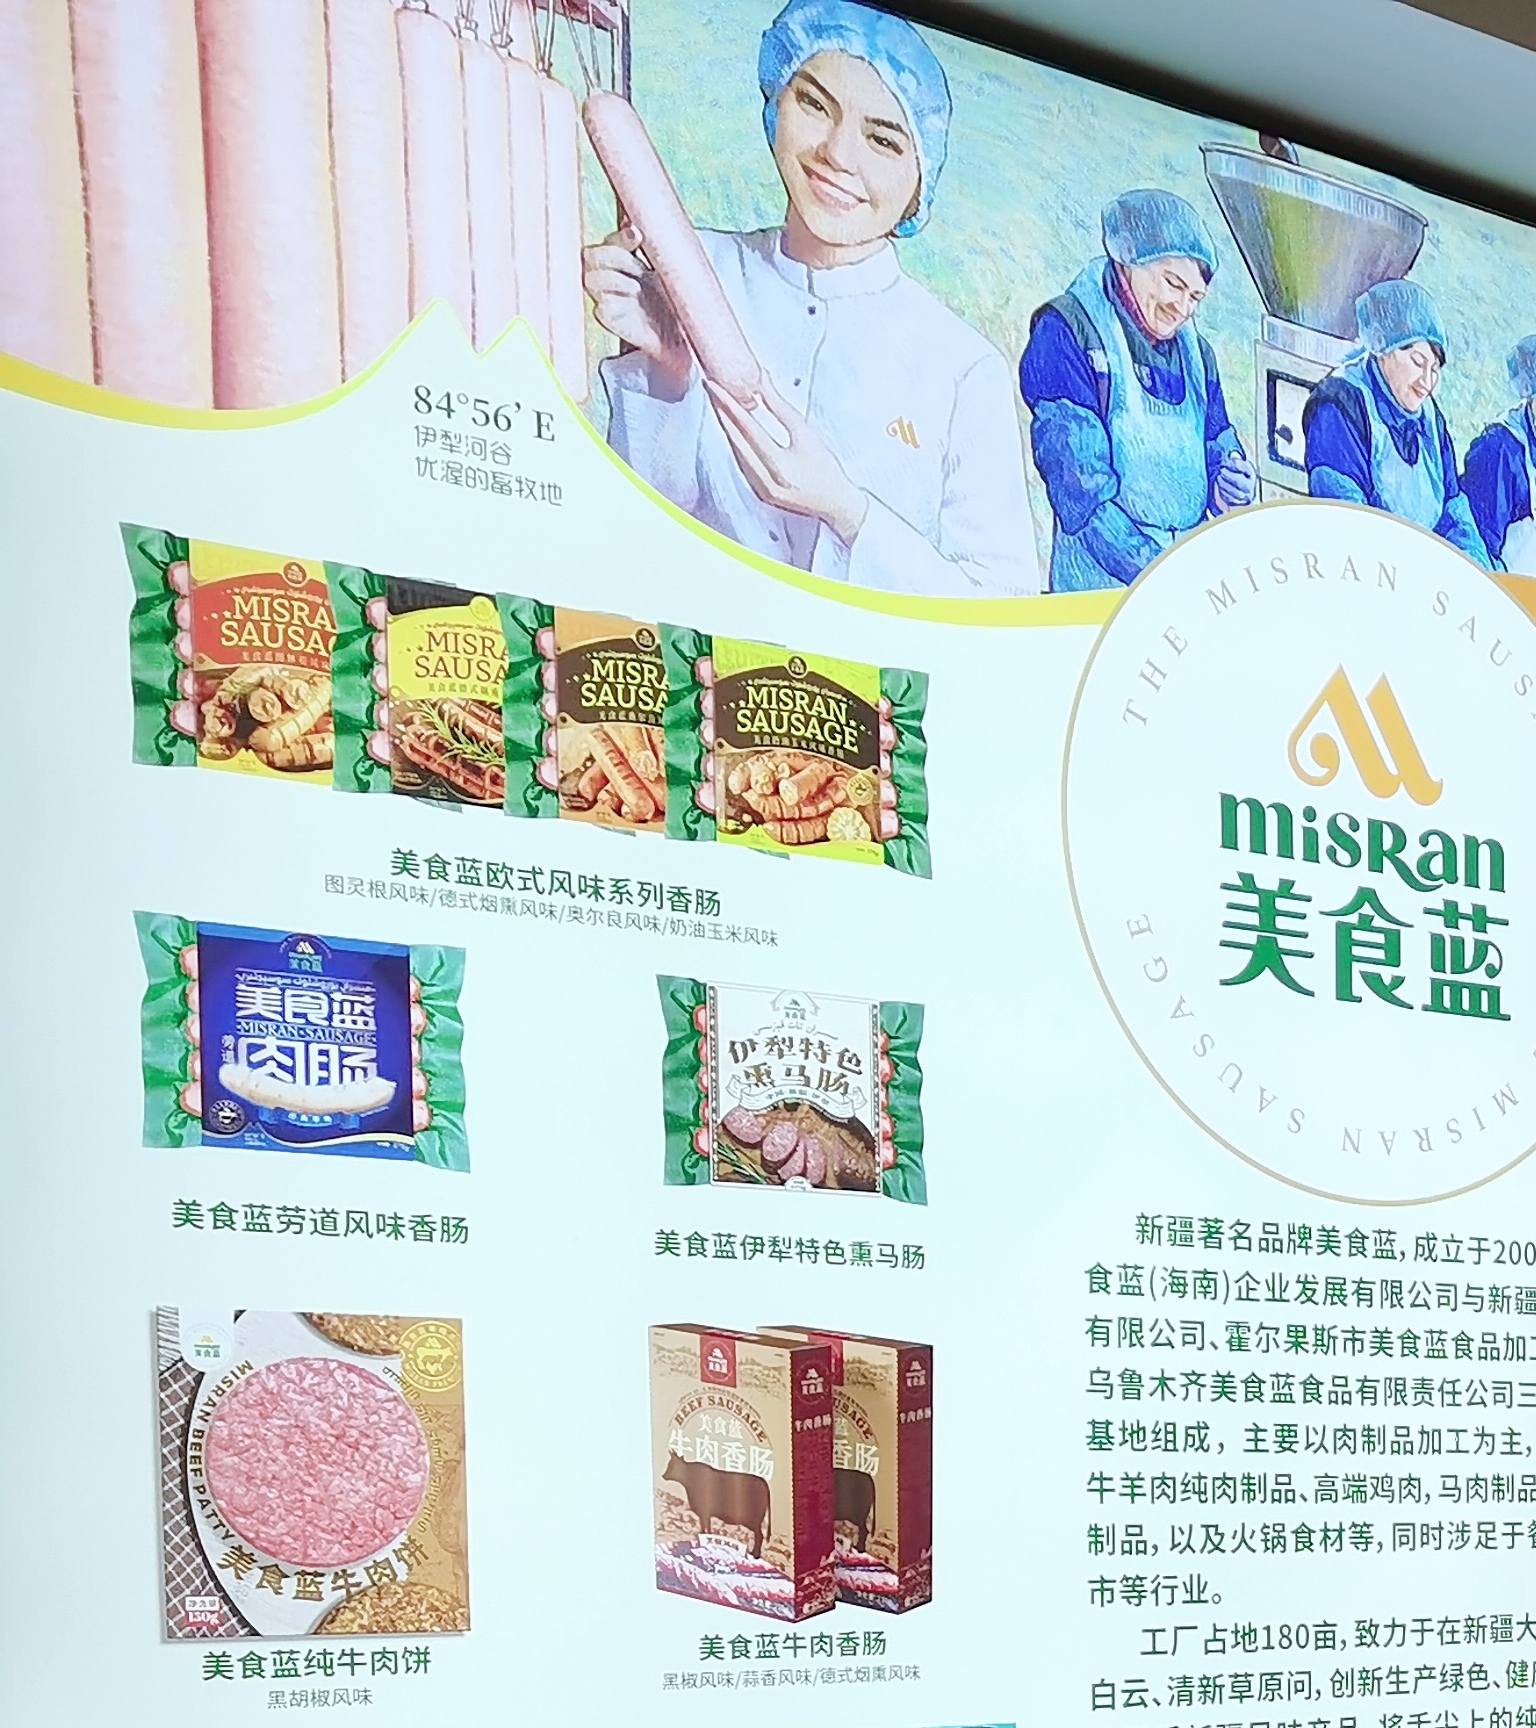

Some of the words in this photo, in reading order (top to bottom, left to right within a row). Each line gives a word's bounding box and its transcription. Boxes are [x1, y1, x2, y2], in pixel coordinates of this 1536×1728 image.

[412, 423, 513, 467] 伊犁河谷
[533, 409, 557, 444] E
[414, 457, 563, 507] 优渥的畜牧地
[220, 620, 337, 655] SAUSA
[1122, 627, 1190, 729] THE
[1204, 552, 1399, 616] MISRAN
[745, 685, 848, 725] MISRAN
[736, 708, 860, 755] SAUSAGE
[390, 847, 722, 918] 美食蓝欧式风味系列香肠
[1218, 872, 1512, 1023] 美食蓝
[235, 984, 376, 1030] 美食蓝
[1126, 913, 1306, 1134] SAUSAGE
[237, 1035, 377, 1085] 肉肠
[728, 1034, 864, 1076] 伊犁特色
[744, 1061, 851, 1096] 熏马肠
[1339, 1081, 1521, 1158] MISRAN
[171, 1197, 469, 1245] 美食蓝劳道风味香肠
[653, 1227, 926, 1270] 美食蓝伊犁特色熏马肠
[699, 1413, 743, 1438] 美食蓝
[668, 1428, 775, 1481] 牛肉香肠
[216, 1534, 430, 1603] 美食蓝牛肉饼
[201, 1645, 433, 1683] 美食蓝纯牛肉饼
[698, 1630, 887, 1661] 美食蓝牛肉香肠
[266, 1686, 374, 1711] 黑胡椒风味
